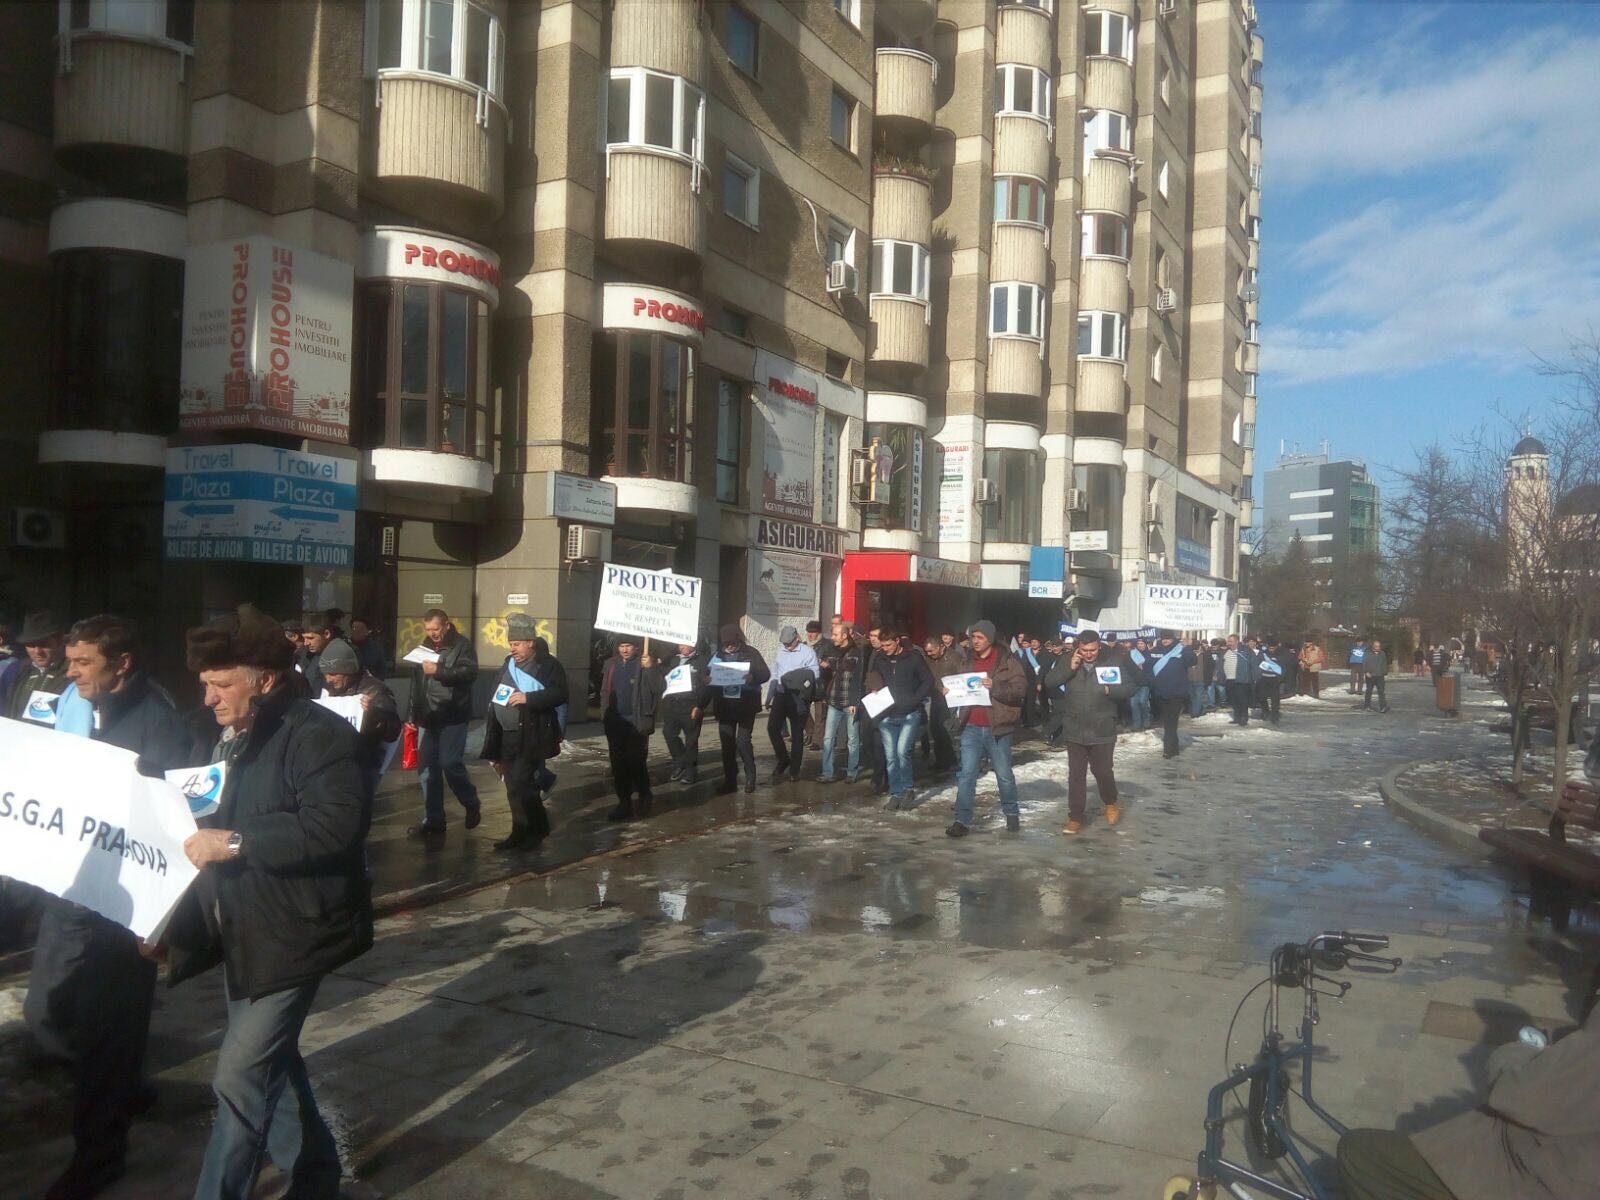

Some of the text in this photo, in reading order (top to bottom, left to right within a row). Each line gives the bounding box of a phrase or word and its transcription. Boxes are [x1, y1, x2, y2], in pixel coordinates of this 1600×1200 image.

[226, 243, 251, 407] PROHOUSE
[268, 246, 294, 411] PROHOUSE
[295, 314, 331, 331] PENTRU
[295, 342, 349, 362] IMOBILIARE
[182, 448, 233, 469] Travel
[273, 449, 338, 479] Travel
[182, 476, 231, 497] Plaza
[273, 477, 335, 506] Plaza
[912, 432, 920, 528] ASIGURARI
[166, 541, 242, 558] BILETE DE AVION
[758, 520, 839, 555] ASIGURARI
[252, 541, 348, 565] BILETE DE AVION
[607, 567, 700, 598] PROTEST
[1031, 586, 1048, 595] BCR
[1149, 586, 1226, 601] PROTEST
